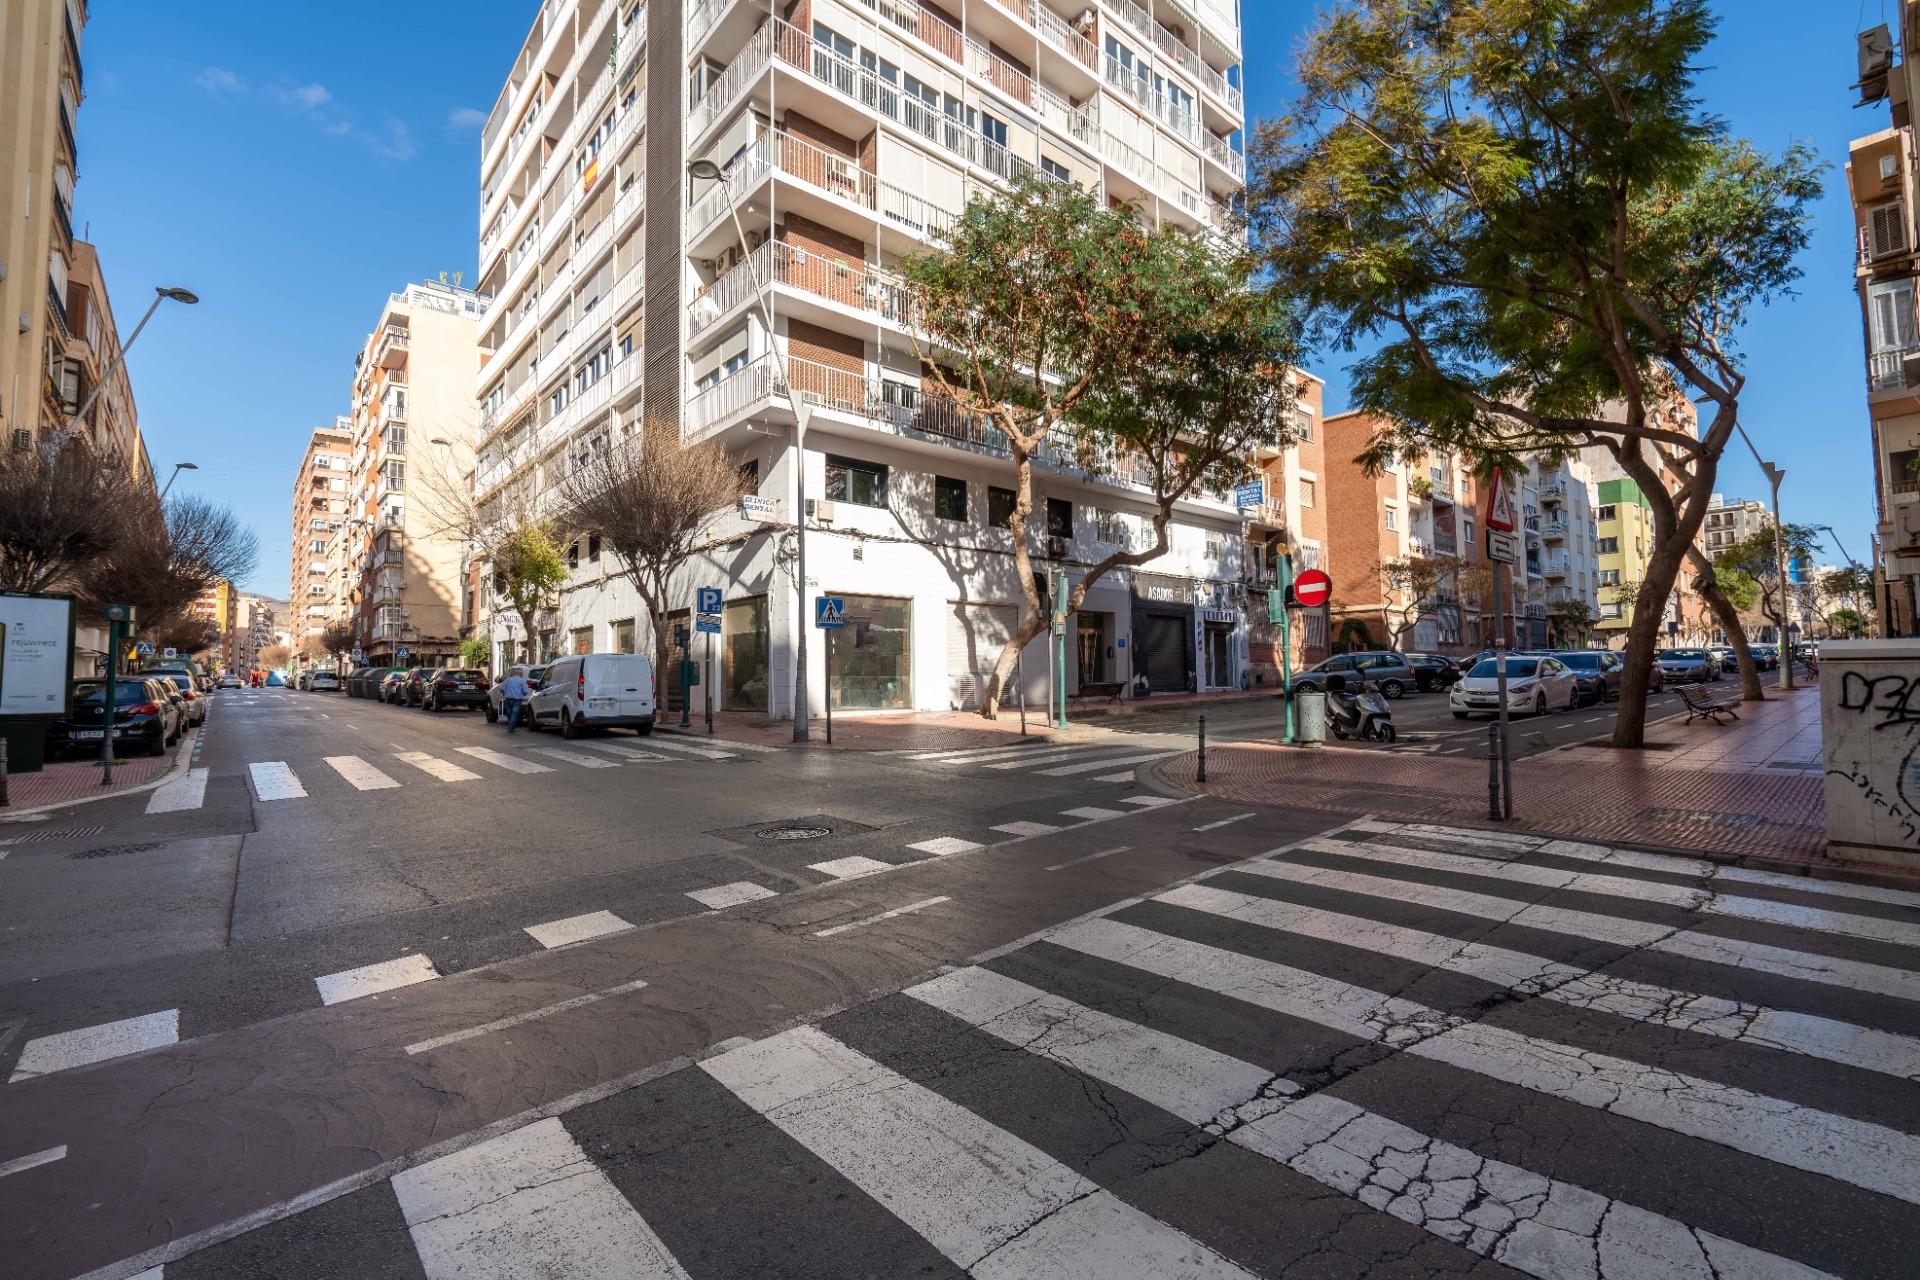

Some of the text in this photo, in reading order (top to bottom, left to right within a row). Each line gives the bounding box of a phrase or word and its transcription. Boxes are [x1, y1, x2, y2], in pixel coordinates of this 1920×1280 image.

[745, 504, 775, 513] DENTAL
[703, 591, 718, 611] P
[1148, 586, 1174, 602] ASADOR
